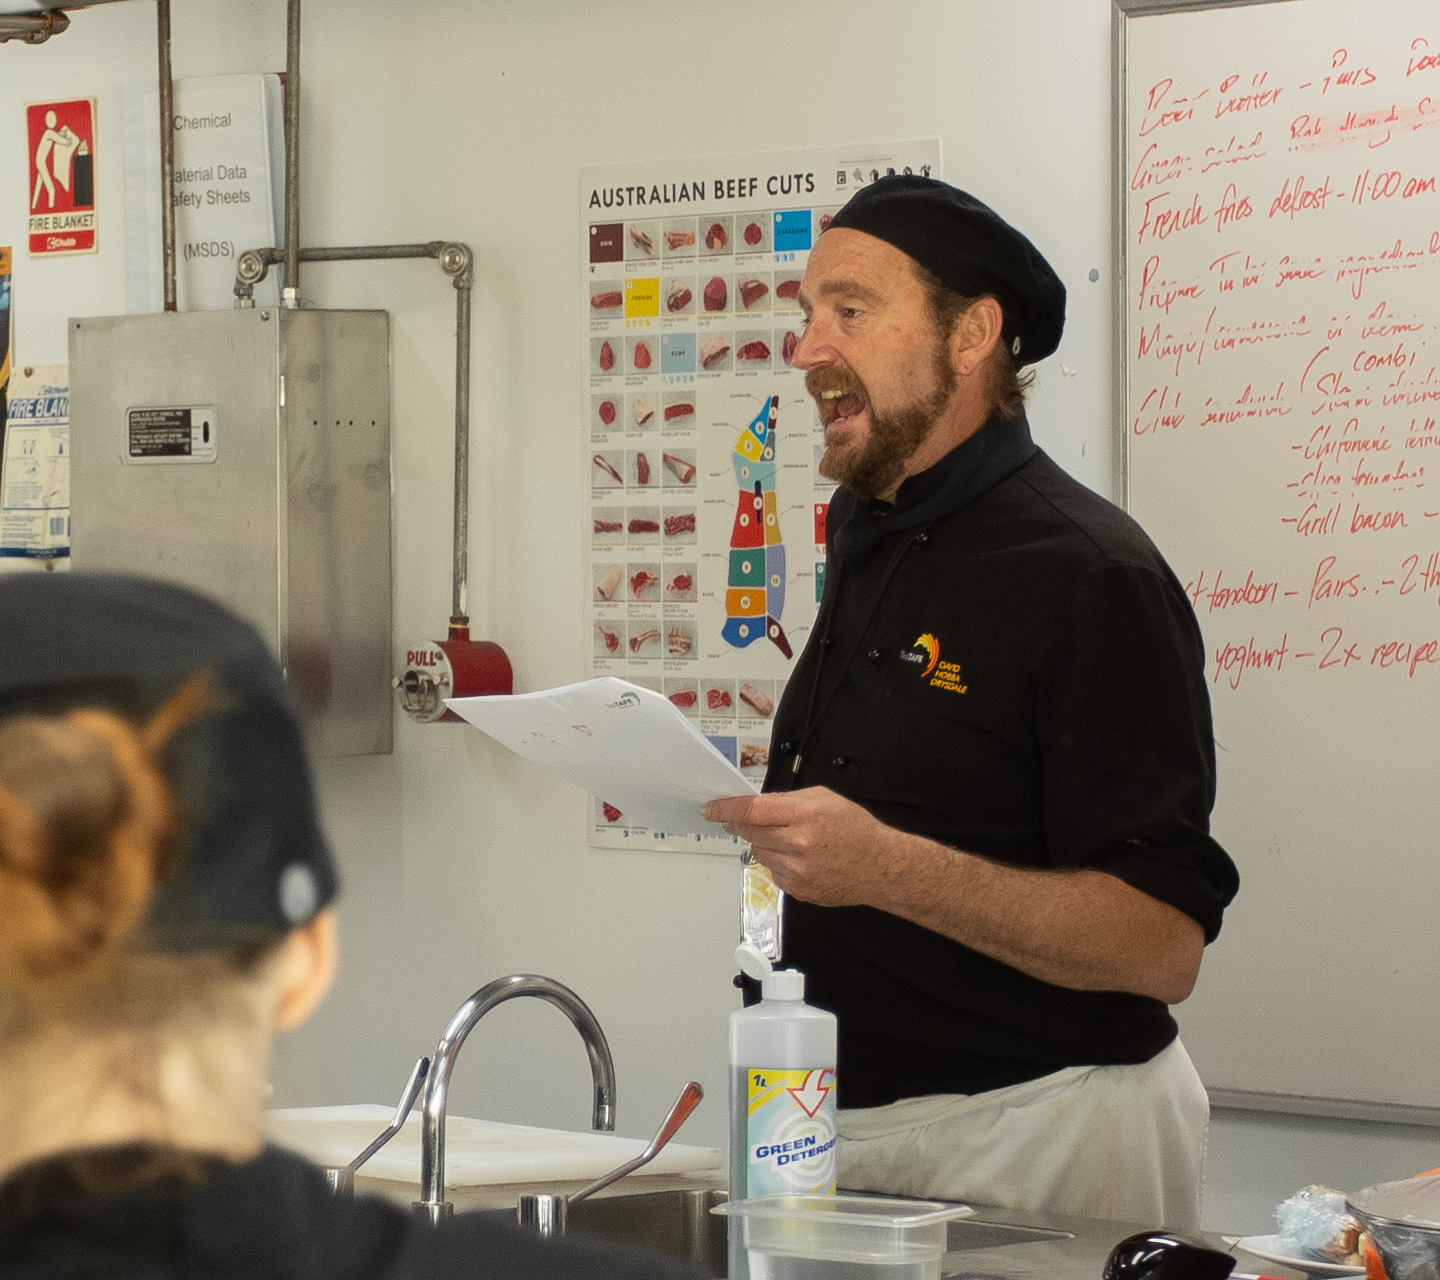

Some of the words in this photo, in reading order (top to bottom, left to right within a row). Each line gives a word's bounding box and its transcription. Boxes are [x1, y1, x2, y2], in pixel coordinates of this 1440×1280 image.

[173, 113, 232, 130] Chemical
[174, 166, 213, 183] aterial
[218, 165, 247, 180] Data
[173, 191, 202, 209] afety
[206, 190, 251, 205] Sheets
[589, 181, 706, 209] AUSTRALIAN
[714, 178, 758, 200] BEEF
[766, 173, 815, 195] CUTS
[1138, 192, 1208, 244] French
[1215, 183, 1253, 233] fries
[1269, 176, 1333, 219] defrost
[29, 218, 50, 231] FIRE
[52, 214, 95, 229] BLANKET
[183, 241, 235, 261] (MSDS)
[9, 400, 34, 418] FIRE
[1350, 502, 1408, 534] bacon
[406, 650, 437, 667] PULL
[1214, 634, 1289, 691] yoghurt
[755, 1134, 816, 1159] GREEN
